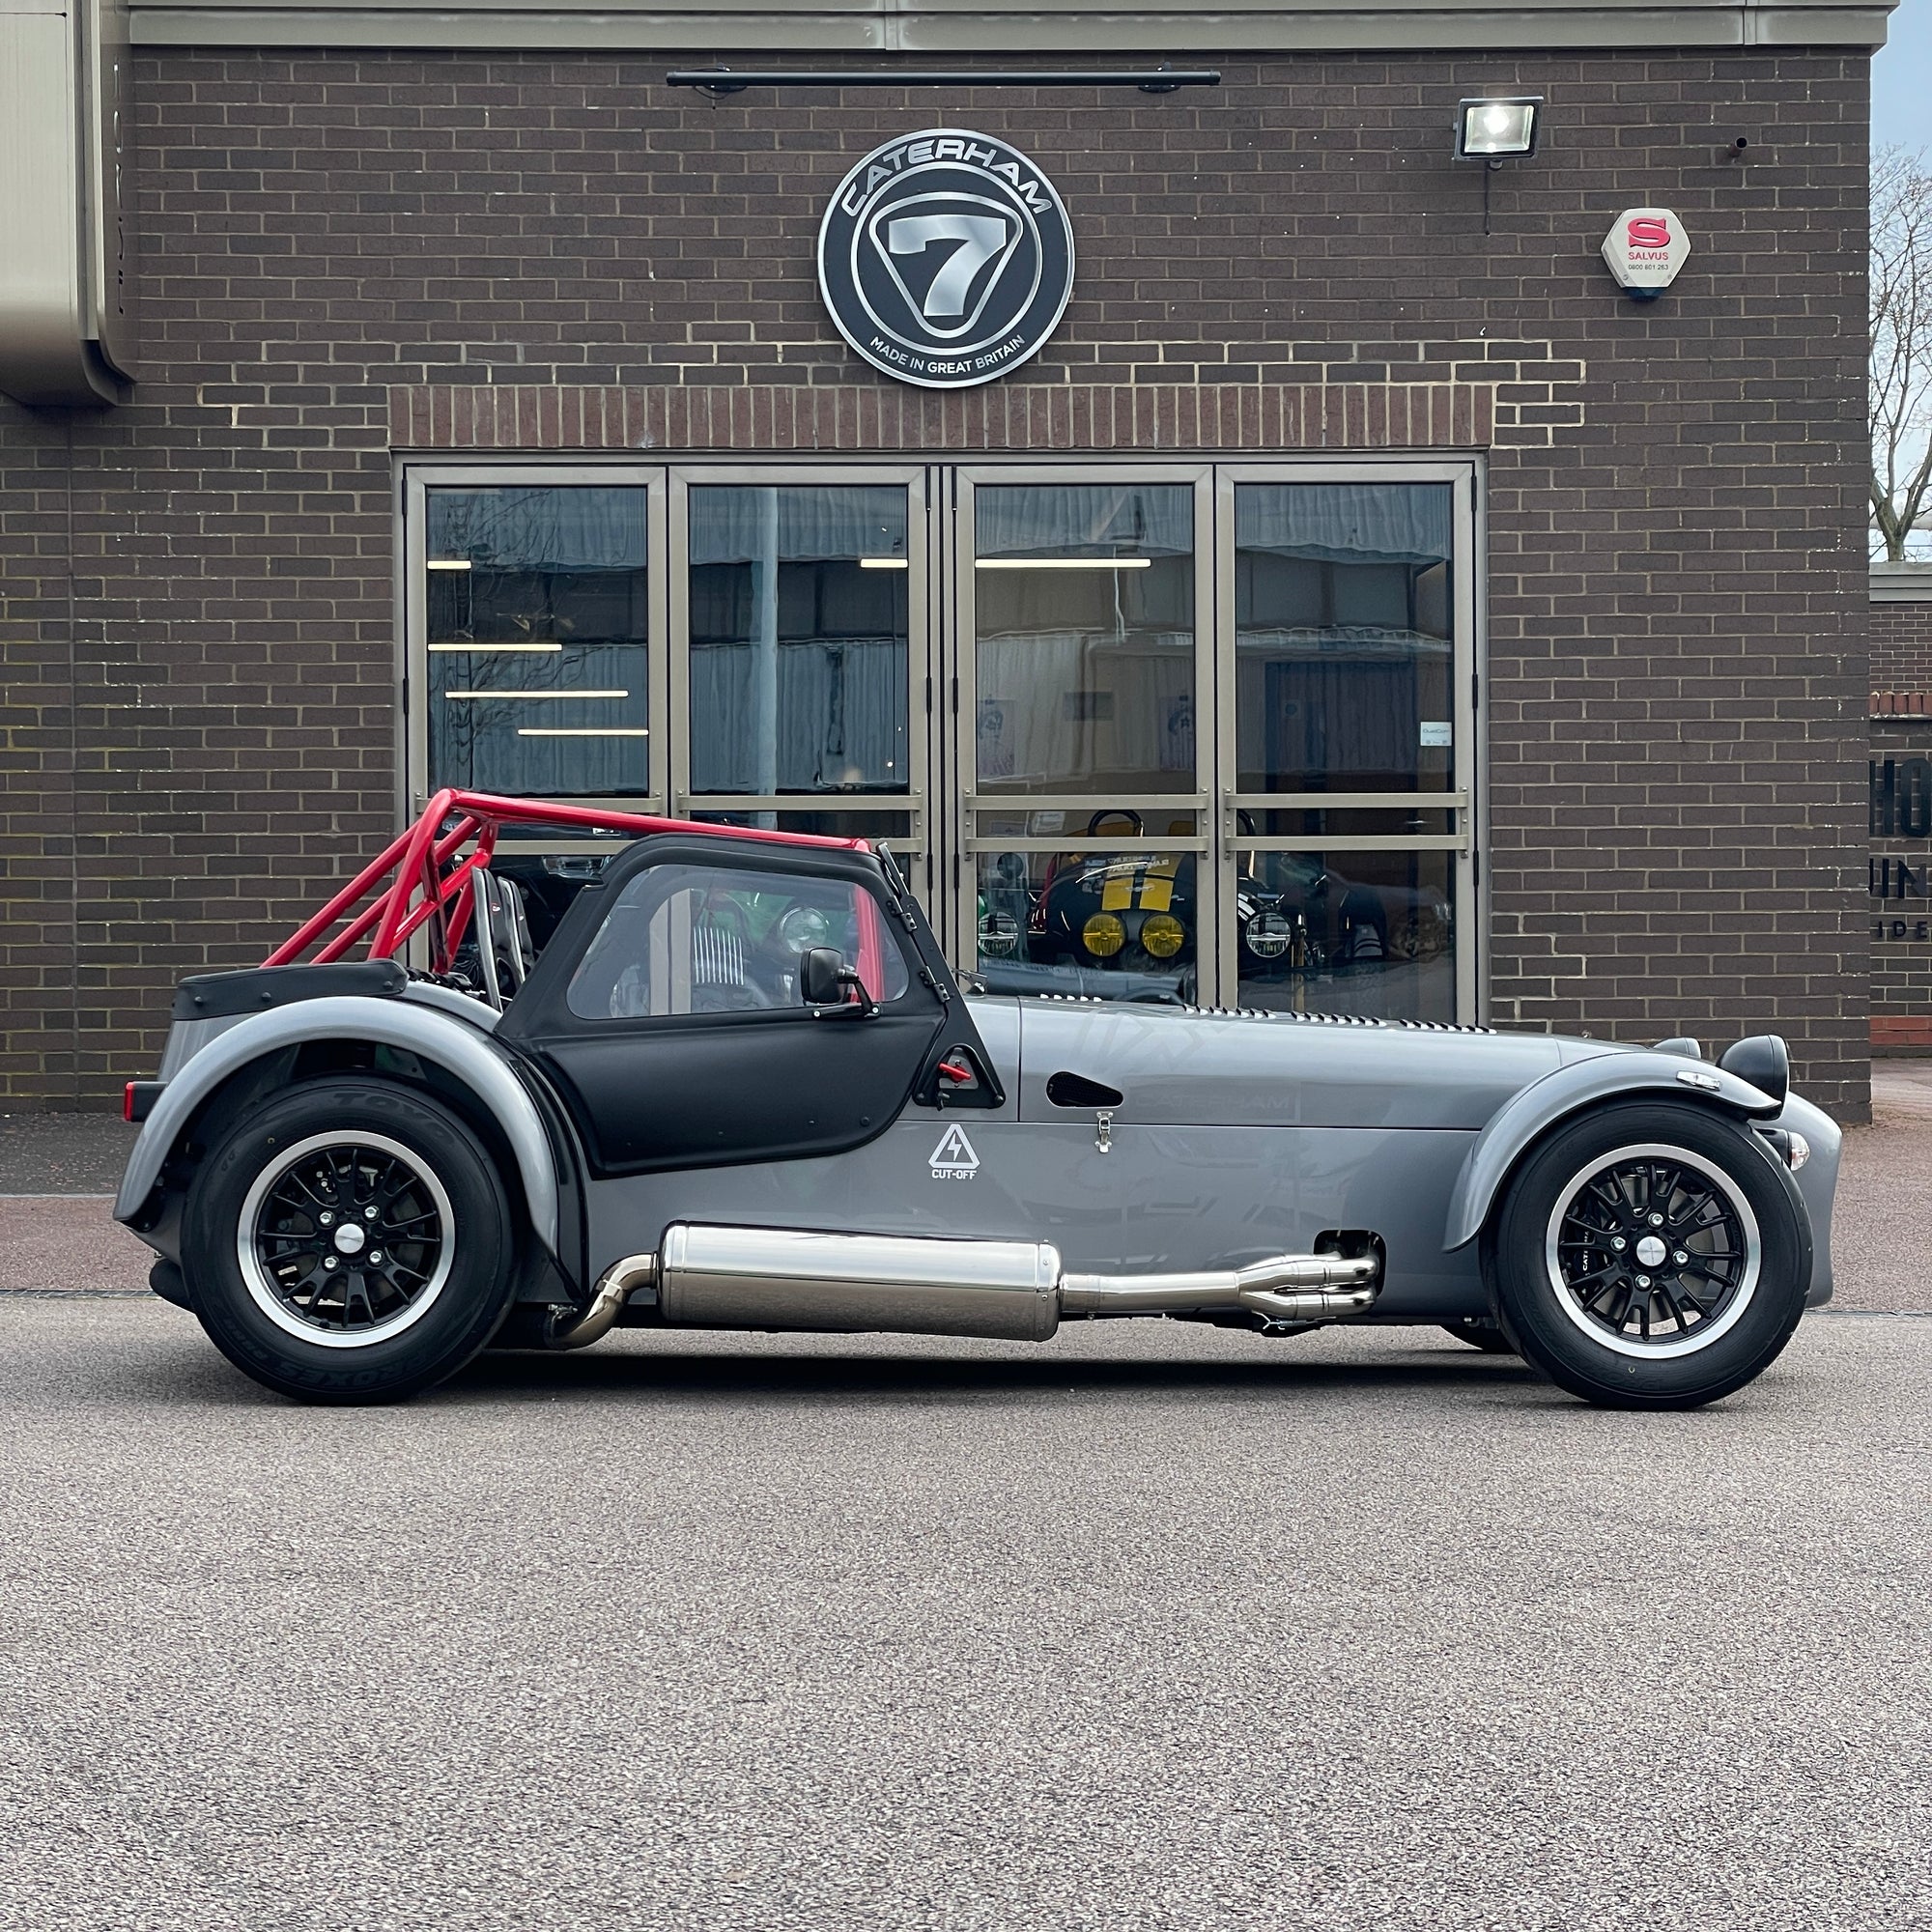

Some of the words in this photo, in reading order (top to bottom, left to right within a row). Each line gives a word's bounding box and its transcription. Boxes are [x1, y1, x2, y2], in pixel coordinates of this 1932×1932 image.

[841, 138, 1053, 217] CATERHAM
[889, 214, 1007, 317] 7
[1628, 251, 1669, 261] SALVUS
[870, 336, 907, 365] MADE
[909, 357, 924, 371] IN
[927, 360, 973, 374] GREAT
[975, 334, 1026, 369] BRITAIN
[1869, 858, 1928, 898] IN
[931, 1169, 977, 1179] CUT-OFF
